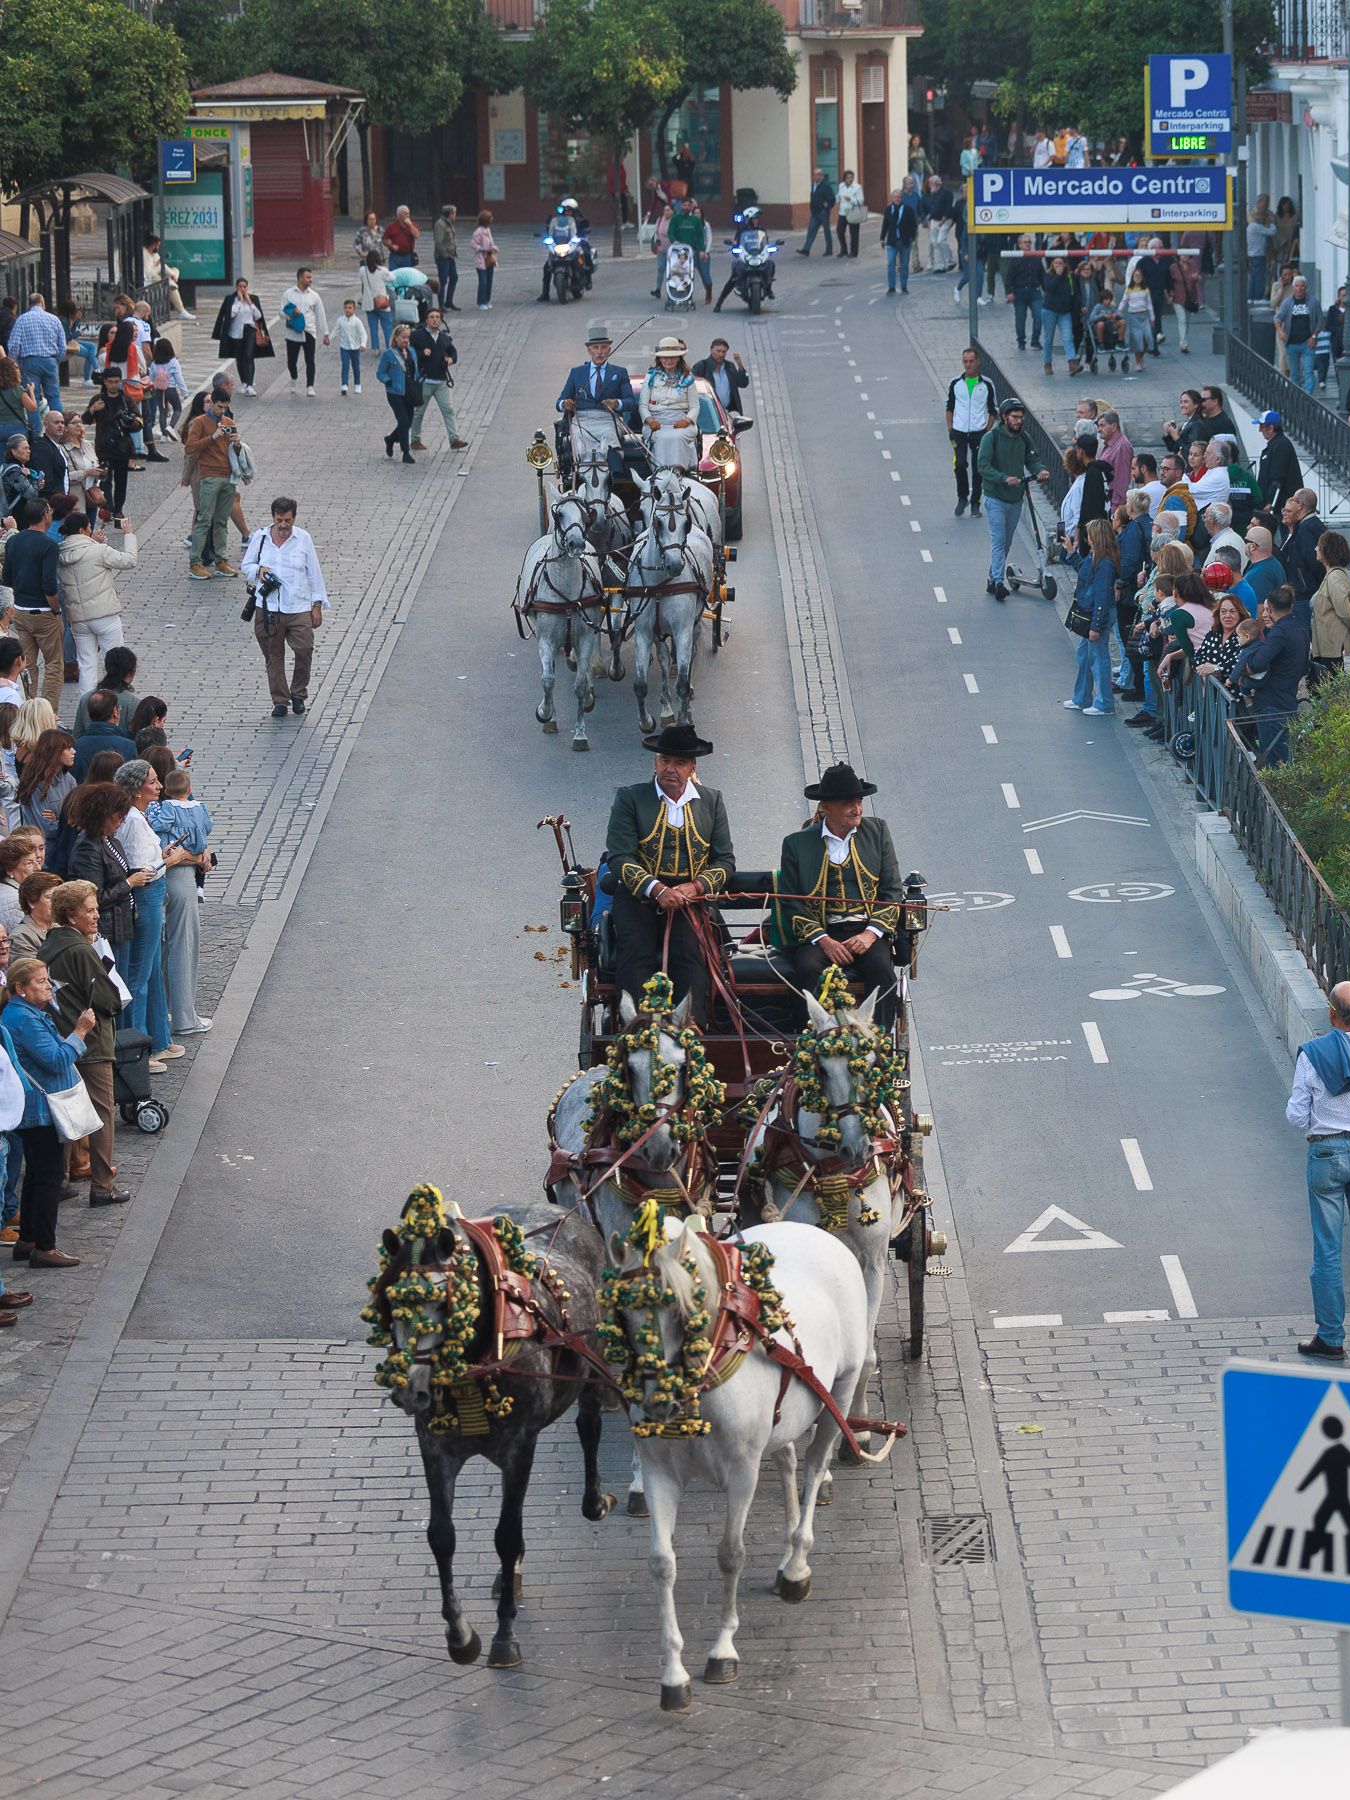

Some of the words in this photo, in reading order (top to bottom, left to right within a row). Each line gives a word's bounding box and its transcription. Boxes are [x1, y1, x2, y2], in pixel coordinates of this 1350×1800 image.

[1170, 58, 1210, 108] P
[1155, 110, 1194, 118] Mercado
[1170, 121, 1223, 131] Interparking
[195, 128, 227, 138] ONCE
[1171, 136, 1206, 150] LIBRE
[982, 173, 1004, 202] P
[1024, 175, 1123, 196] Mercado
[192, 211, 218, 225] 2031
[1162, 208, 1217, 218] Interparking
